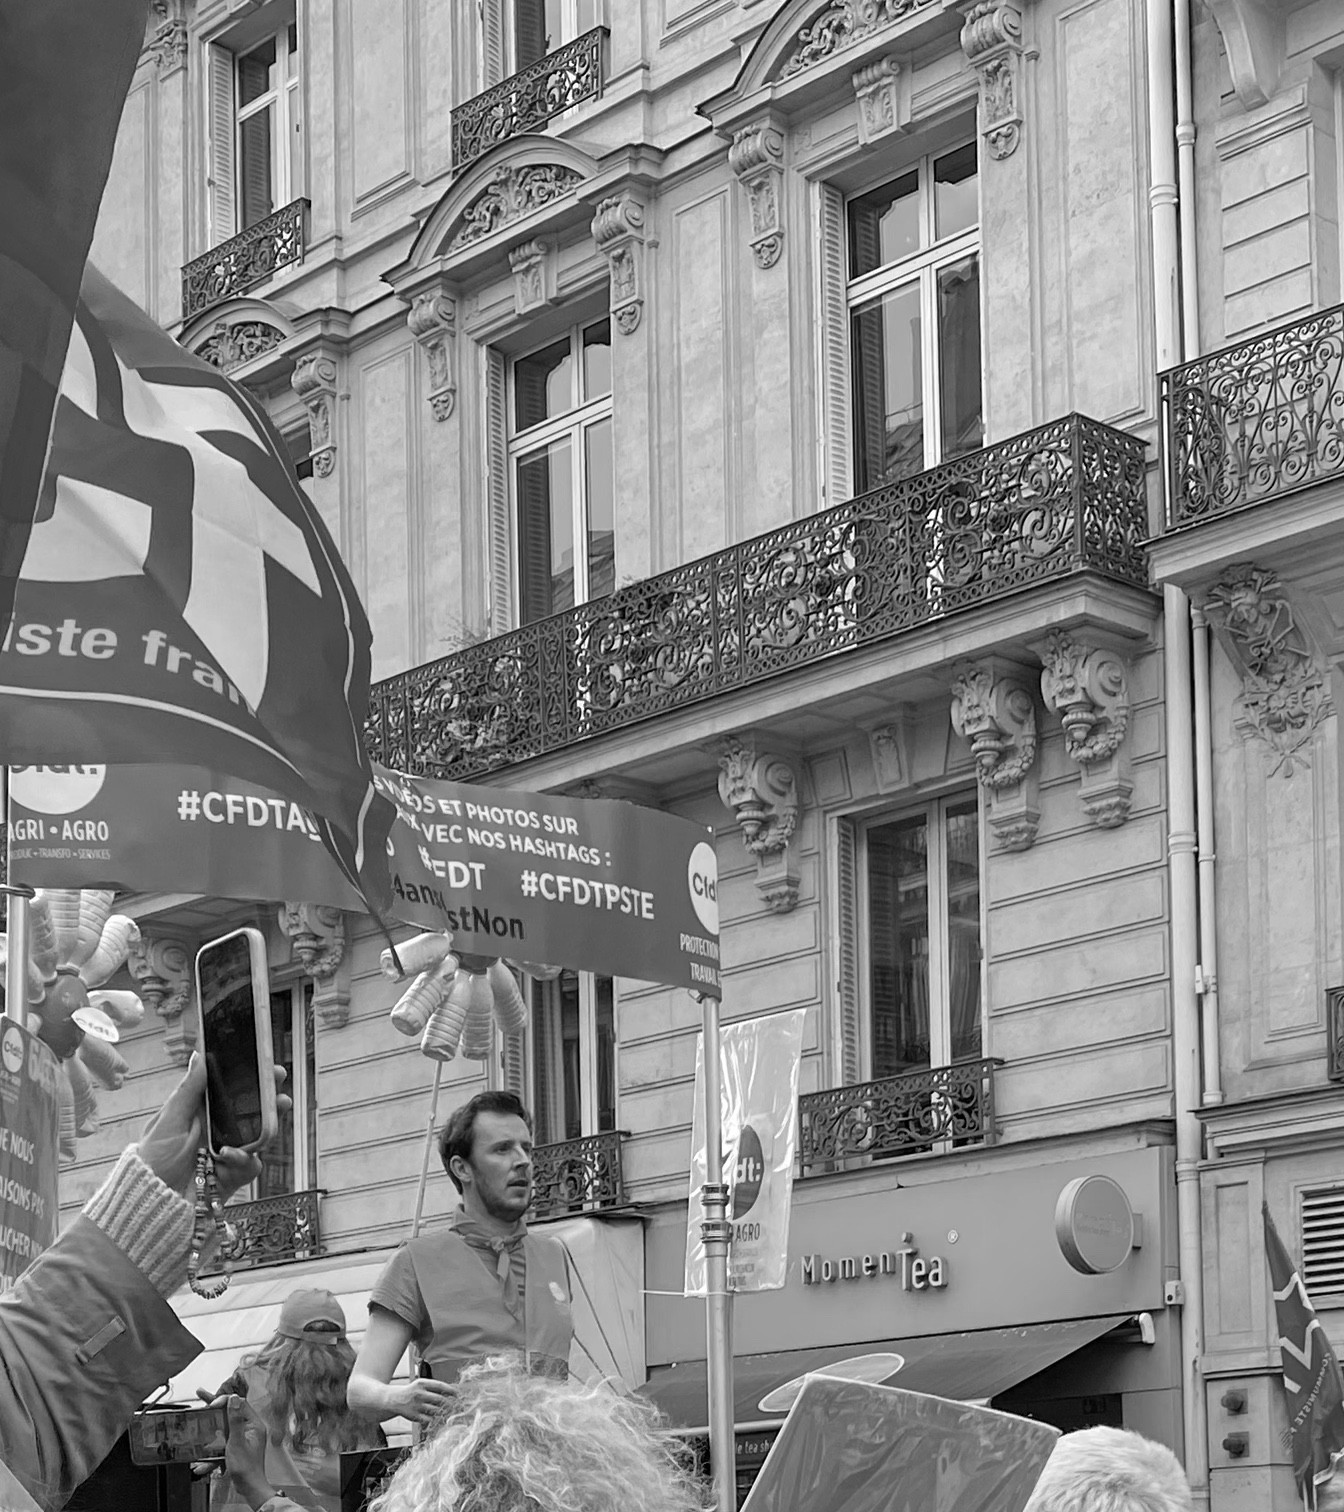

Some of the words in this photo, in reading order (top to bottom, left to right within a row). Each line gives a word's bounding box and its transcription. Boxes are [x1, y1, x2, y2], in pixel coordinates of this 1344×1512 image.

[62, 819, 109, 841] AGRO
[437, 798, 464, 817] ET
[467, 802, 540, 829] PHOTOS
[543, 815, 579, 836] SUR
[421, 823, 464, 846] VEC
[467, 826, 506, 850] NOS
[509, 834, 601, 866] HASHTAGS
[520, 869, 655, 920] #CFDTPSTE
[692, 873, 718, 902] Cfd
[10, 1132, 35, 1165] NOUS
[736, 1156, 762, 1184] dt:
